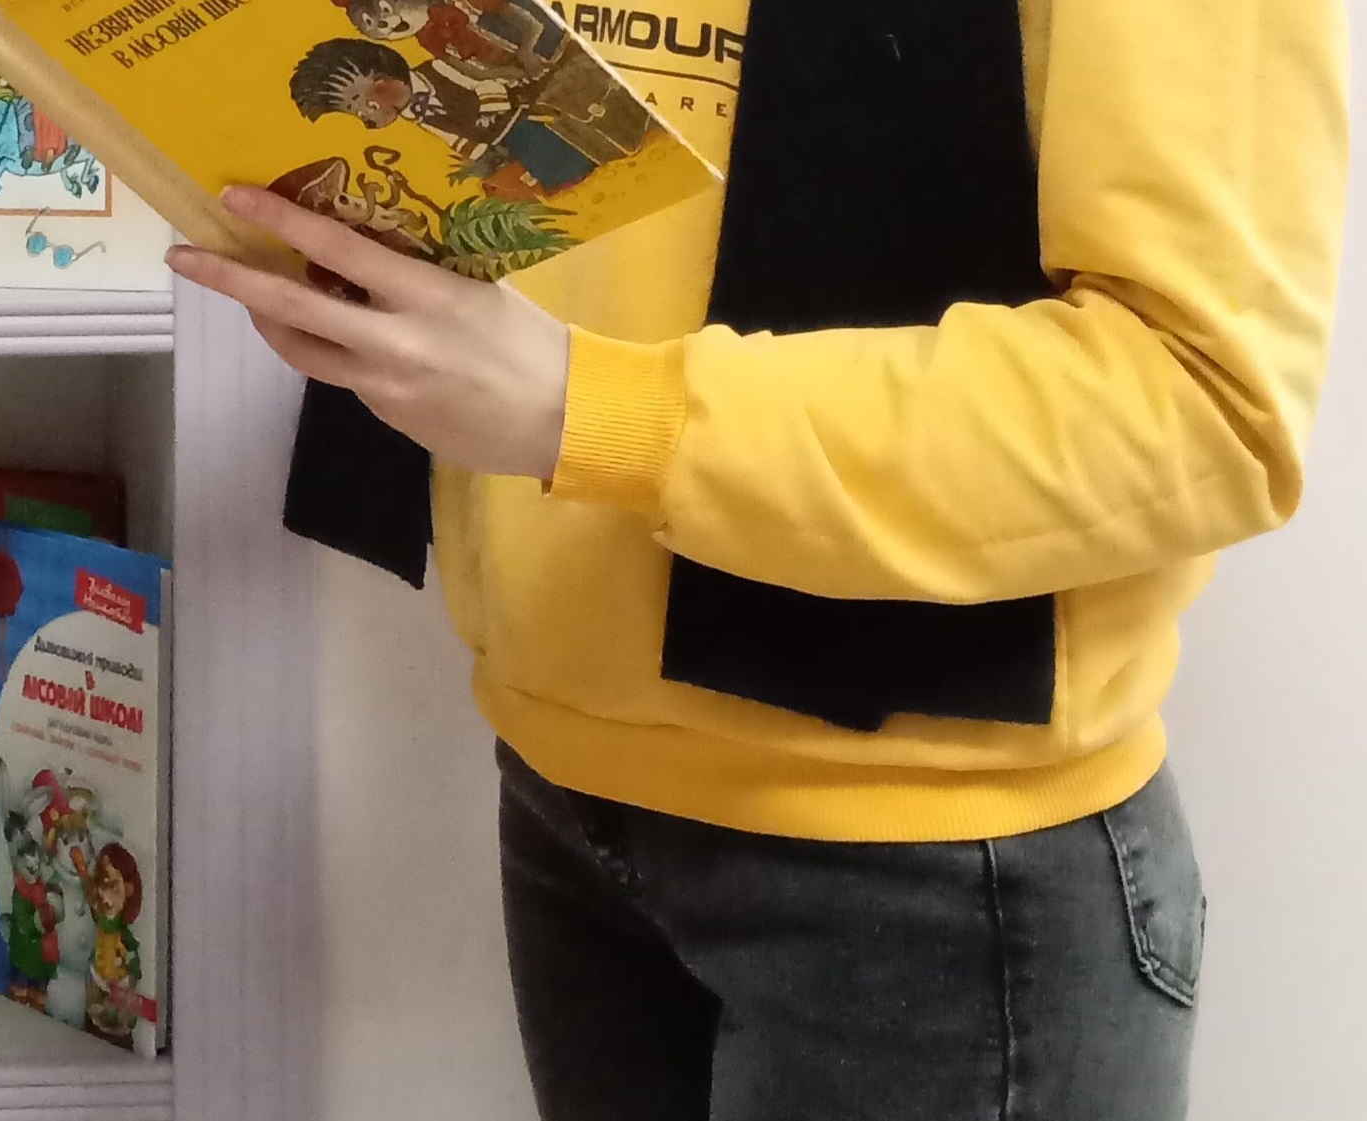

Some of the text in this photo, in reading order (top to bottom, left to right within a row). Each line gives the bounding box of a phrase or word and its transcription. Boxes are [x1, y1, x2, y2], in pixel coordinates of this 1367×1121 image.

[111, 49, 135, 70] В
[22, 674, 86, 717] ЛІСОВІЙ
[89, 694, 144, 735] ШКОЛІ
